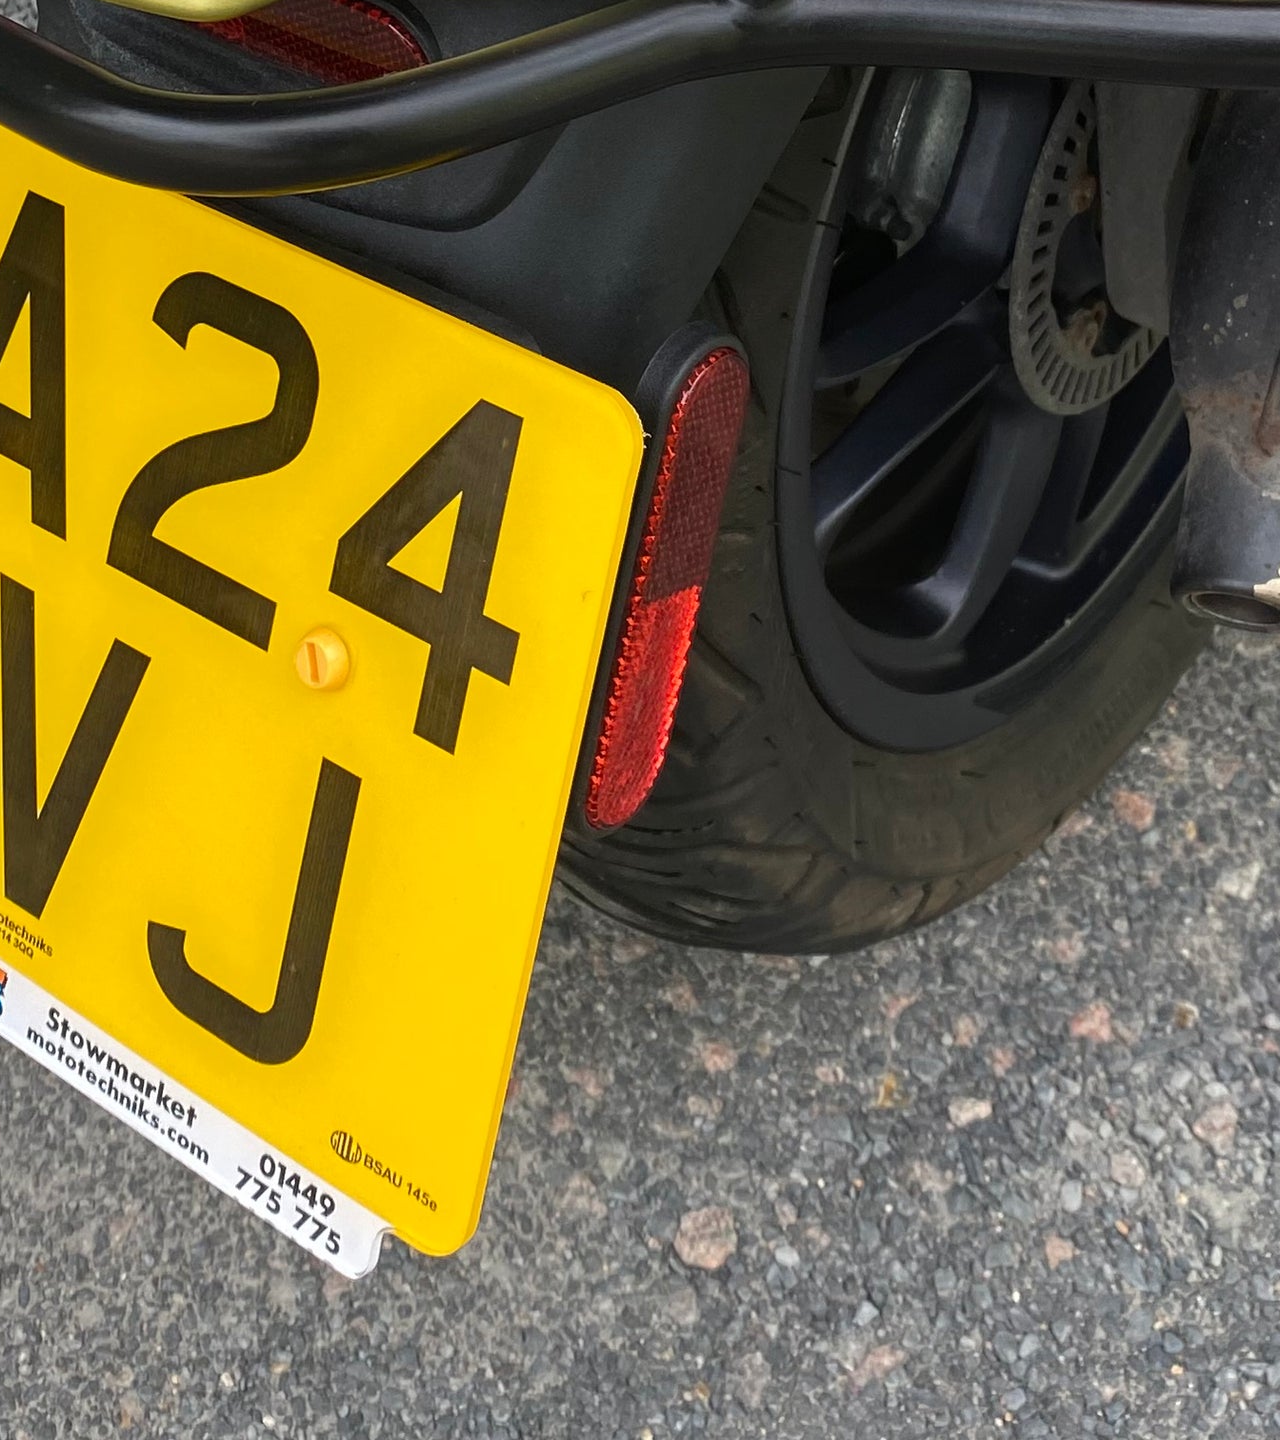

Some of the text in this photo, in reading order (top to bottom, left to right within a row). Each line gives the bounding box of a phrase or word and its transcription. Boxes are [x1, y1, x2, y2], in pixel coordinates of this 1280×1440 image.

[26, 1025, 210, 1165] mototechniks.com
[45, 1006, 198, 1129] Stowmarket
[234, 1166, 341, 1257] 775 775
[258, 1152, 337, 1219] 01449
[363, 1153, 403, 1189] BSAU
[406, 1182, 438, 1213] 145e
